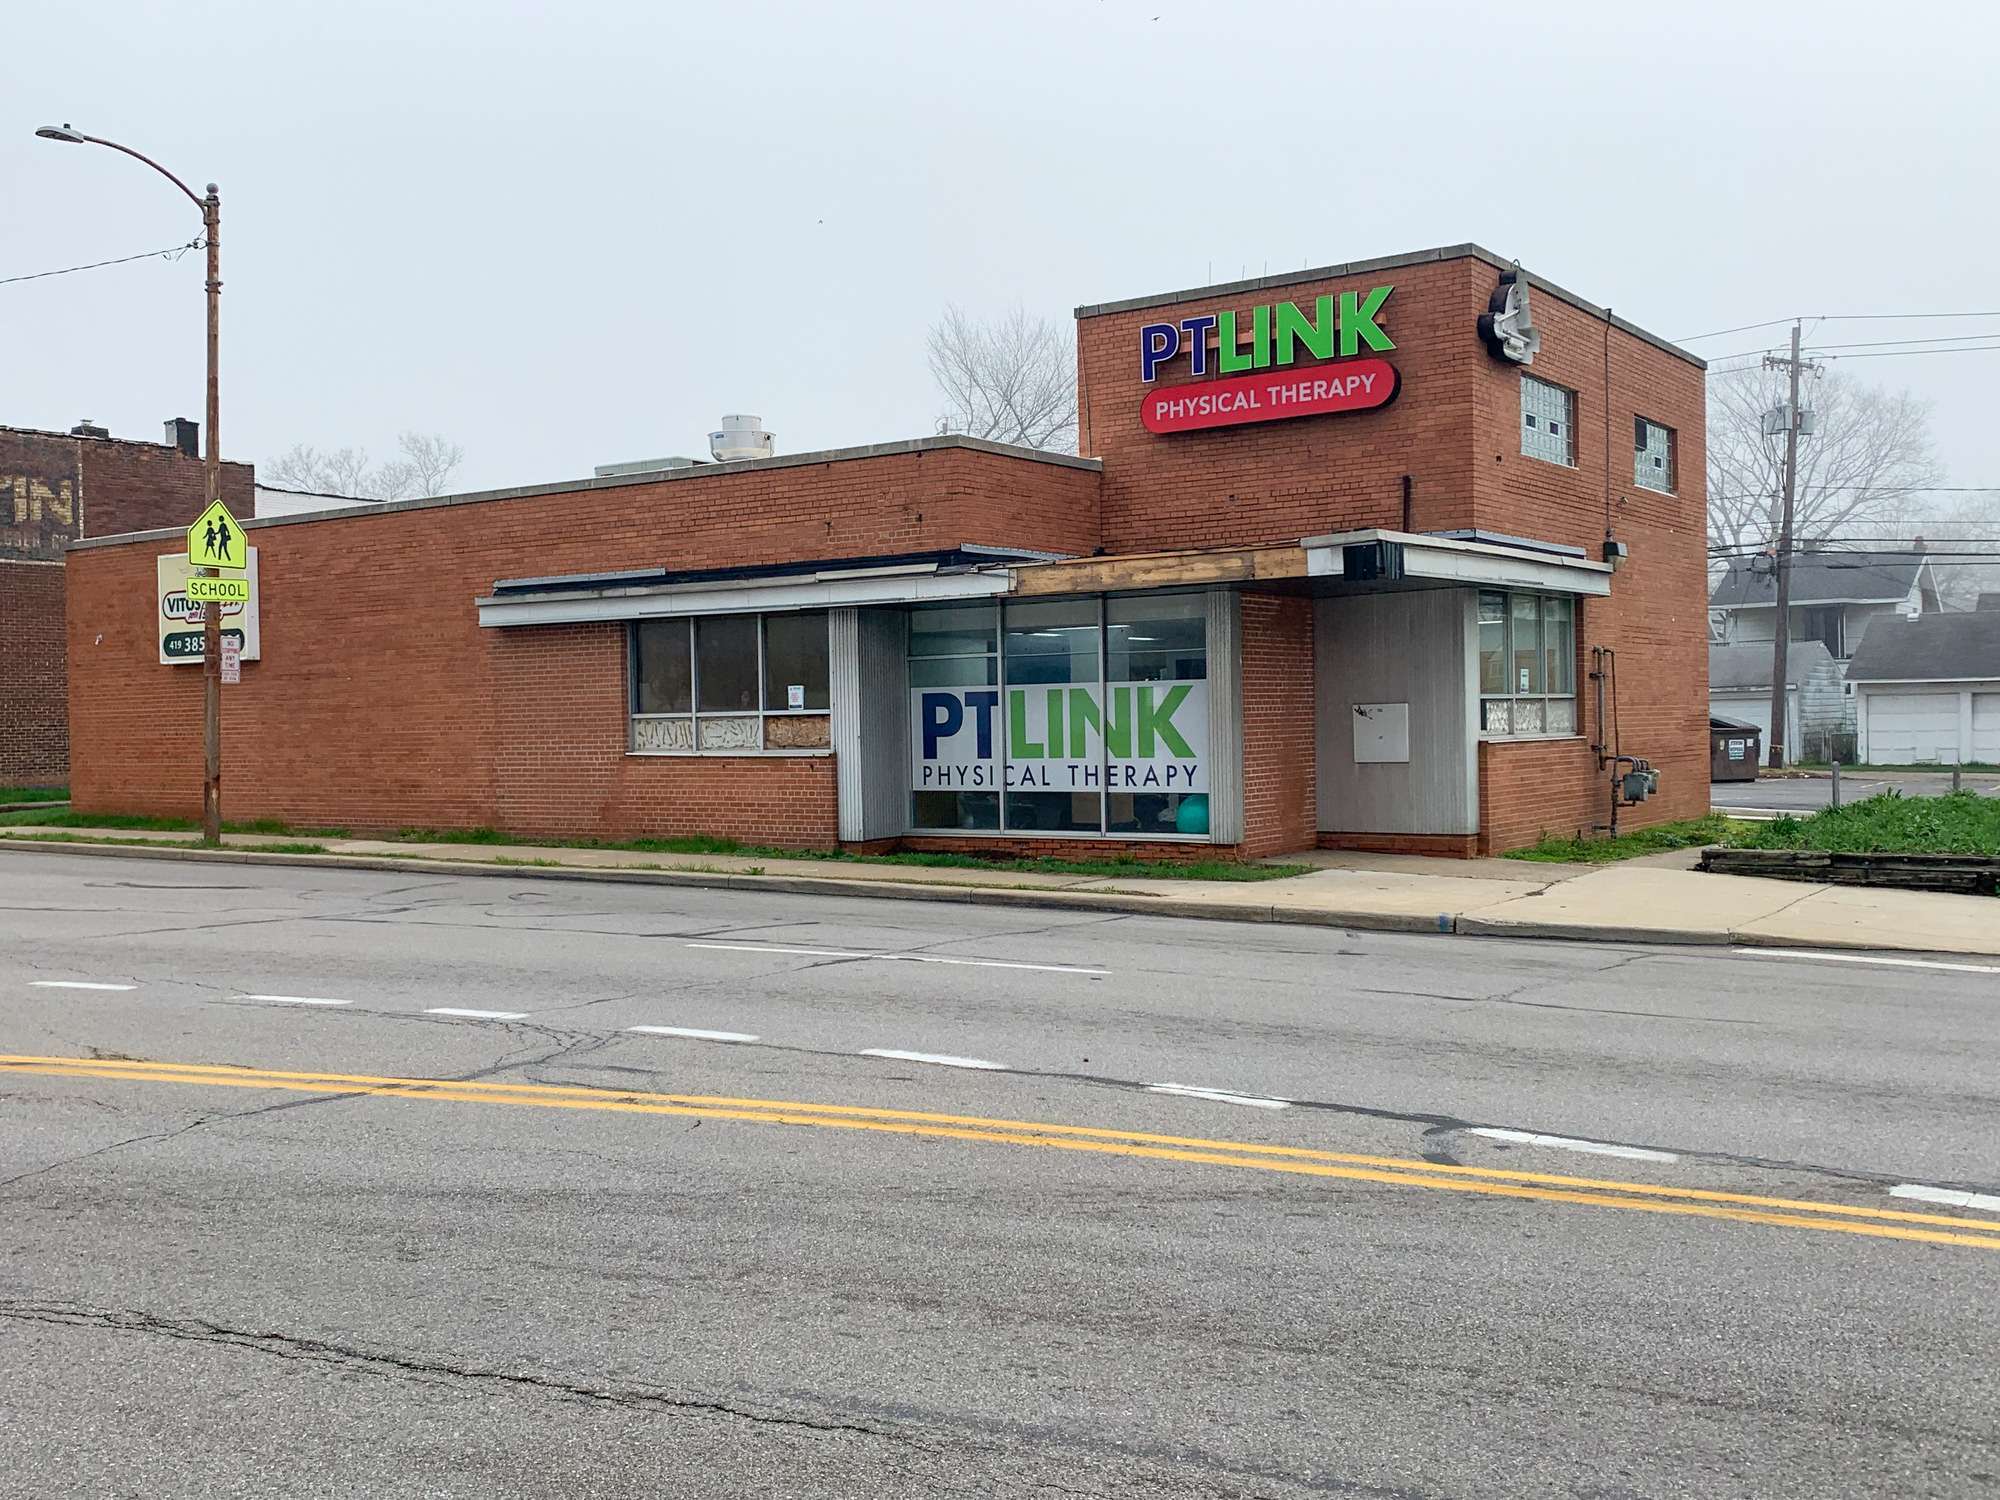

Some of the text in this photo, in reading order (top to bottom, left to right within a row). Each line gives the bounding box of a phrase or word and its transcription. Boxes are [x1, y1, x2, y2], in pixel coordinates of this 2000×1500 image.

[1156, 373, 1377, 420] PHYSICAL THERAPY
[191, 582, 245, 597] SCHOOL
[169, 639, 182, 650] 419
[922, 764, 1198, 788] PHYSICAL THERAPY
